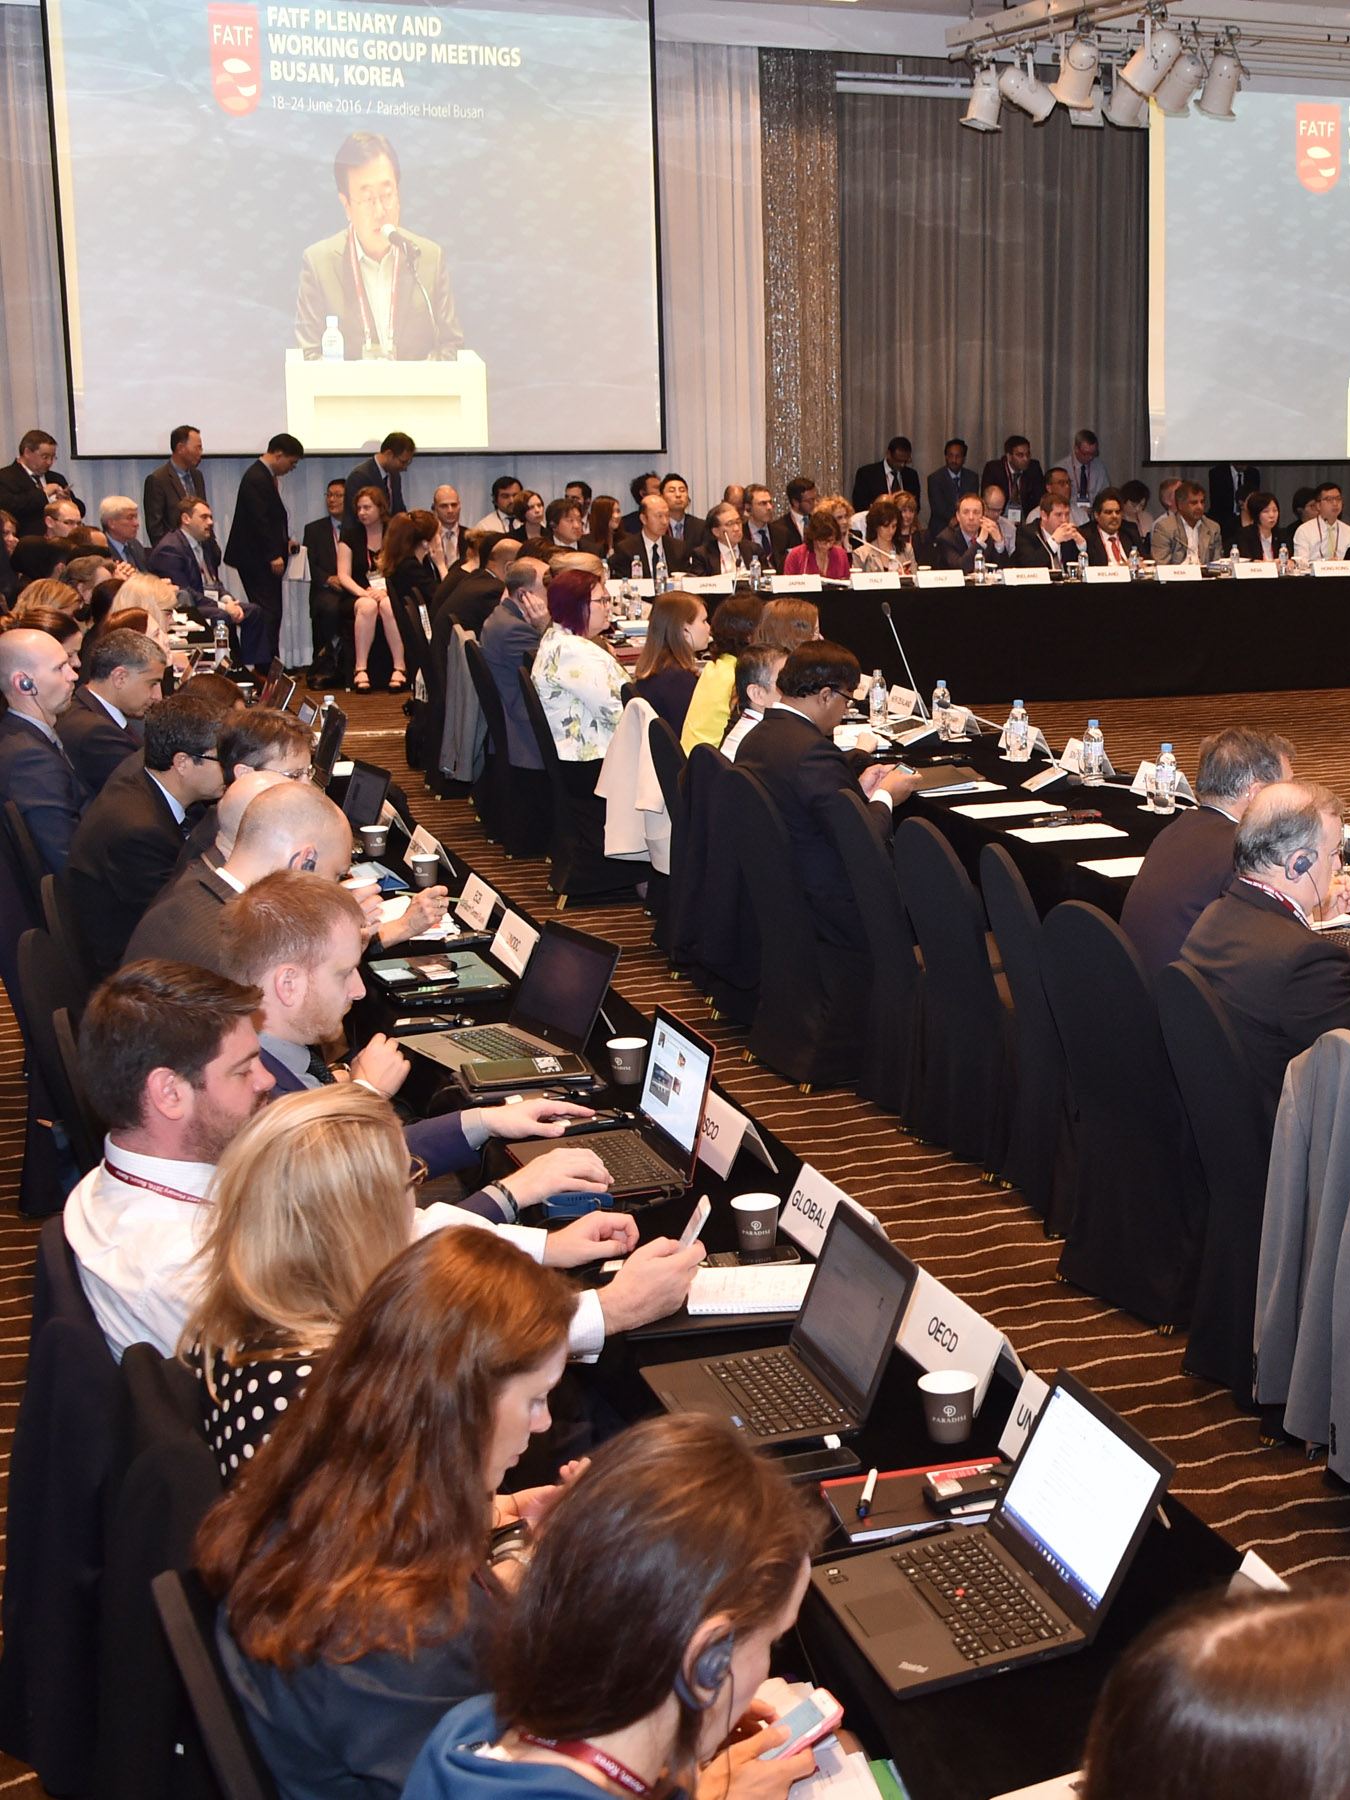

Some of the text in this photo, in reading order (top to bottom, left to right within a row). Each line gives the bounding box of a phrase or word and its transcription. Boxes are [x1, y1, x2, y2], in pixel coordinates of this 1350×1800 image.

[213, 24, 254, 46] FATF
[268, 7, 442, 37] FATF PLENARY AND
[267, 33, 522, 68] WORKING GROUP MEETINGS
[269, 63, 405, 88] BUSAN, KOREA
[306, 98, 333, 113] June
[336, 99, 362, 114] 2016
[376, 101, 420, 117] Paradise
[423, 104, 451, 118] Hotel
[453, 105, 485, 119] Busan
[1299, 119, 1336, 138] FATF
[702, 1114, 720, 1140] SCO
[792, 1189, 828, 1229] GLOBAL
[927, 1316, 959, 1353] OECD
